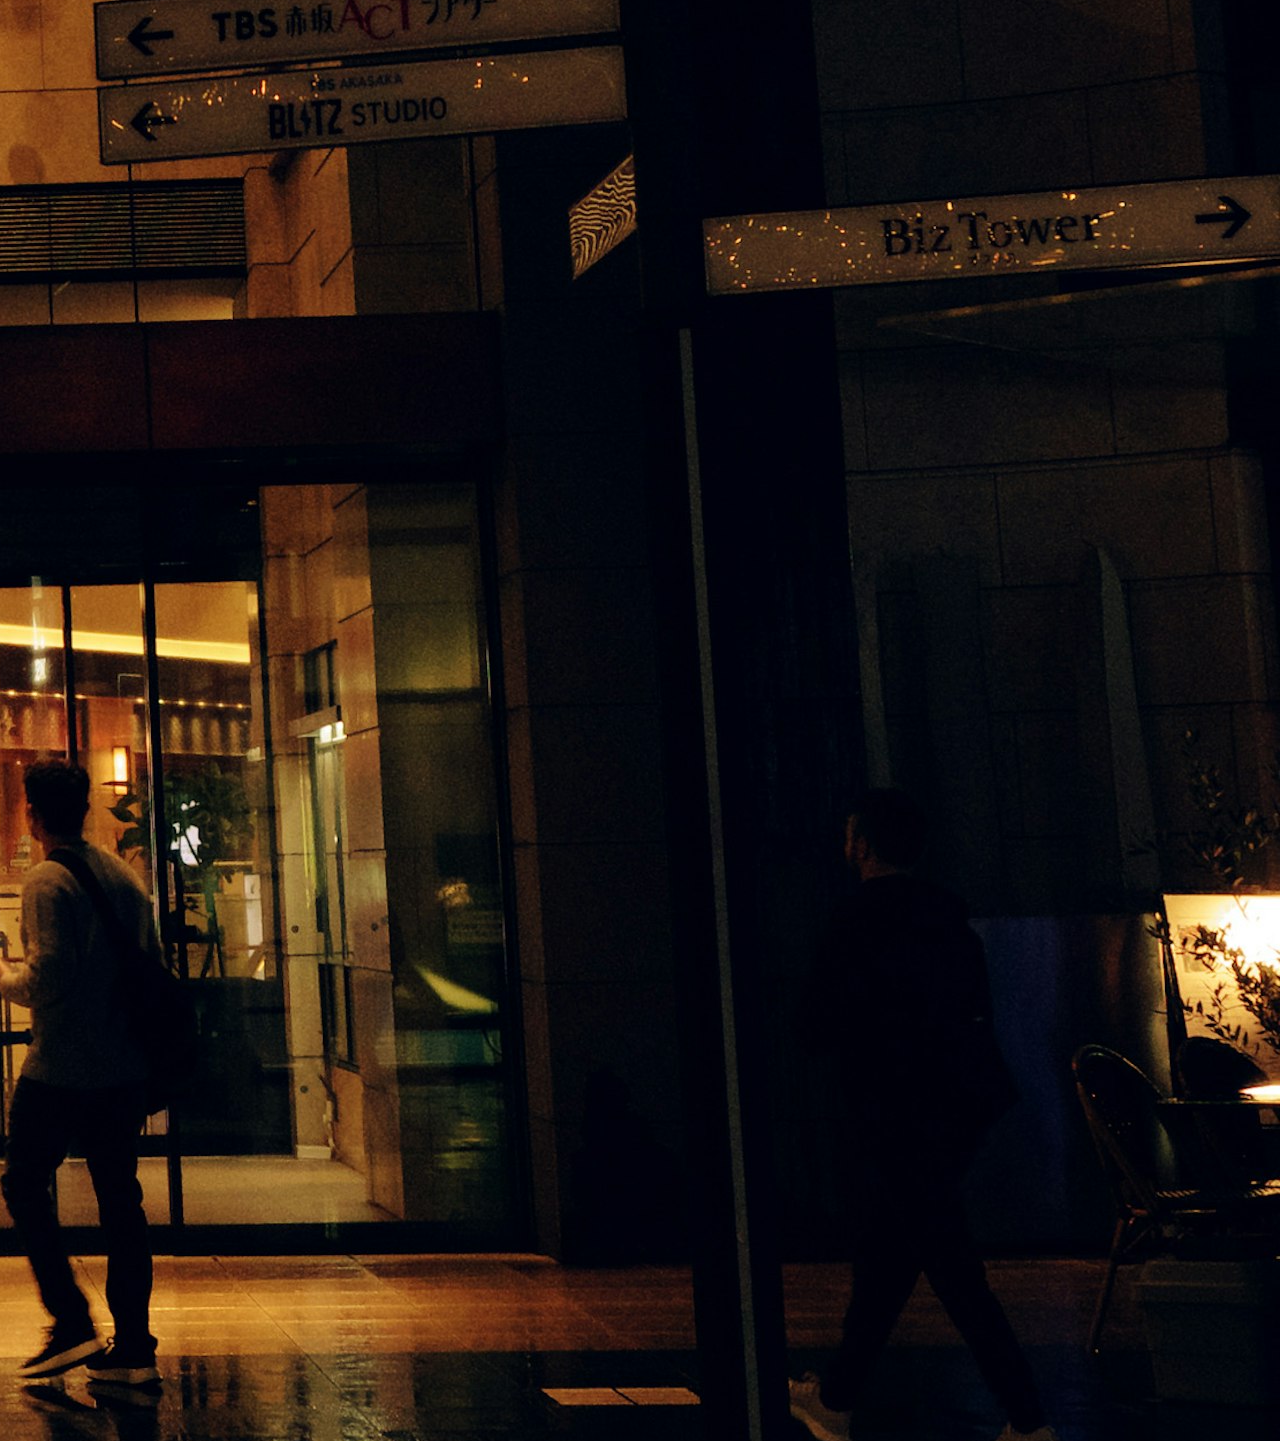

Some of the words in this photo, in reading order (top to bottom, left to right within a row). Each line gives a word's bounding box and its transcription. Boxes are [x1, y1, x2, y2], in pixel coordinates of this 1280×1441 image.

[211, 8, 278, 41] TBS
[340, 73, 403, 89] AKASAKA
[268, 99, 343, 140] BLITZ
[351, 96, 447, 126] STUDIO
[881, 216, 951, 256] Biz
[958, 212, 1100, 249] Tower
